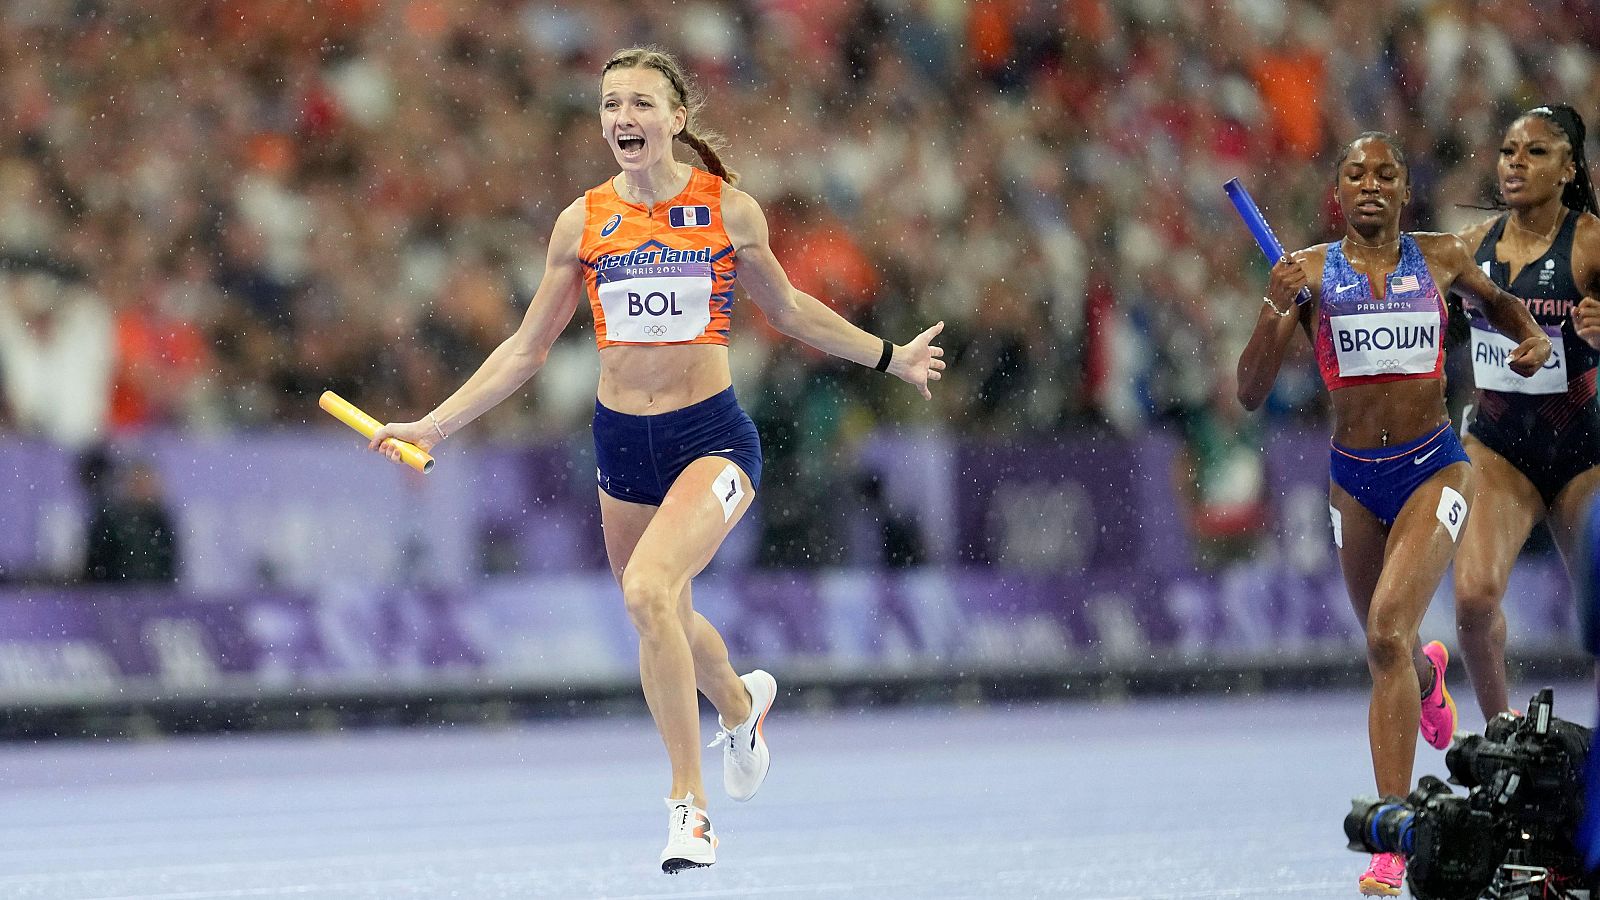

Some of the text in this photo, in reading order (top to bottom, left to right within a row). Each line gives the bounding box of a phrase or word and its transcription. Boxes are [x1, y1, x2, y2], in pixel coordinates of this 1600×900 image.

[626, 266, 653, 275] PARIS
[628, 291, 683, 316] BOL
[1357, 303, 1384, 311] PARIS
[1338, 326, 1435, 352] BROWN
[1448, 500, 1462, 526] 5
